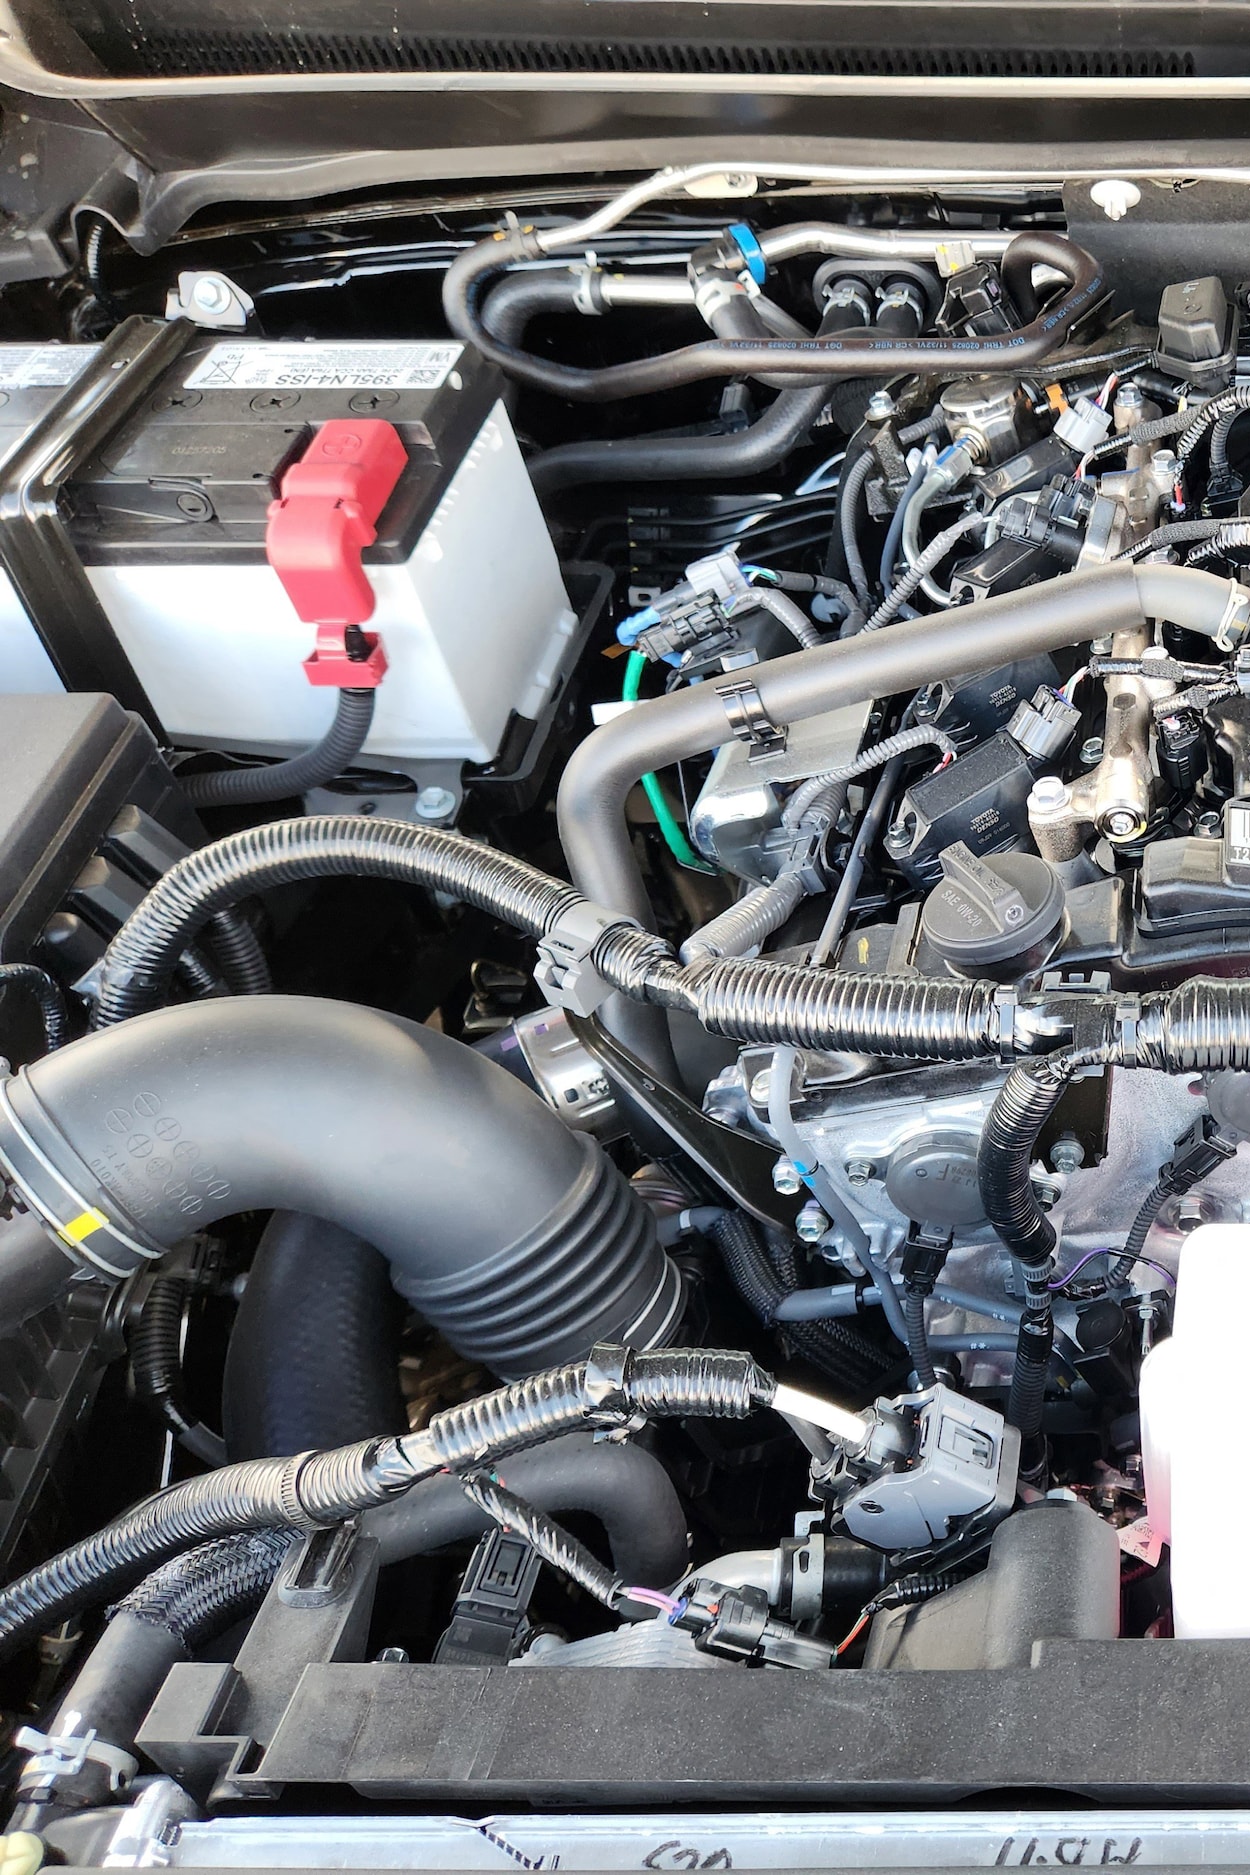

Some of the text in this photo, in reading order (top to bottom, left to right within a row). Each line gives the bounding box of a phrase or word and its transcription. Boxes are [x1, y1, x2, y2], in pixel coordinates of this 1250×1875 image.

[1008, 337, 1025, 348] DOT
[275, 374, 399, 386] 395LN4-ISS
[995, 692, 1016, 708] DENSO
[970, 808, 996, 825] TOYOTA
[976, 816, 1000, 833] DENSO
[948, 844, 986, 878] ENGINE OIL
[941, 889, 983, 927] SAE 0W-20
